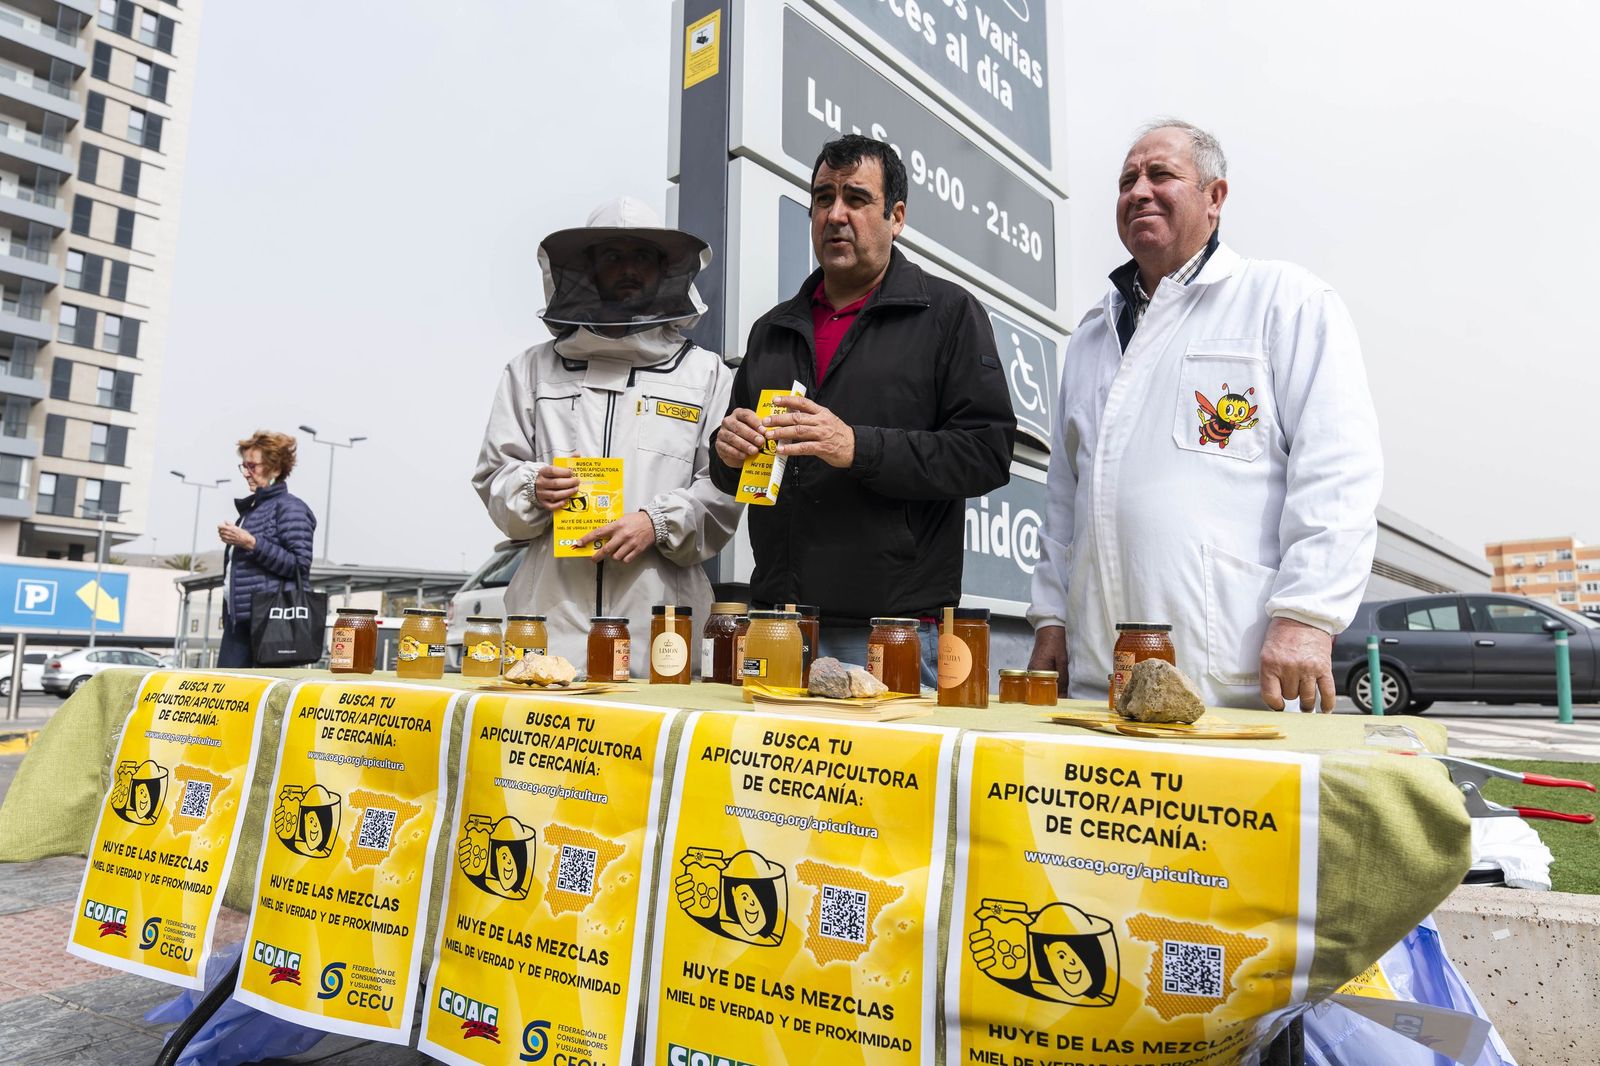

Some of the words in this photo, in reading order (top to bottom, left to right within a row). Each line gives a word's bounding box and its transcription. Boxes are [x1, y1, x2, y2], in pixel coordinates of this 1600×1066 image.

[975, 6, 1043, 88] varias
[946, 32, 968, 74] al
[977, 54, 1013, 112] día
[807, 76, 842, 133] Lu
[911, 150, 965, 211] 9:00
[986, 202, 1042, 262] 21:30
[178, 680, 209, 693] BUSCA
[211, 683, 226, 693] TU
[338, 693, 375, 707] BUSCA
[380, 696, 396, 709] TU
[143, 692, 249, 713] APICULTOR/APICULTORA
[158, 709, 172, 721] DE
[171, 710, 219, 727] CERCANÍA:
[298, 706, 432, 733] APICULTOR/APICULTORA
[525, 711, 571, 730] BUSCA
[577, 717, 595, 733] TU
[321, 726, 335, 740] DE
[336, 727, 397, 747] CERCANÍA:
[479, 726, 643, 761] APICULTOR/APICULTORA
[762, 731, 820, 753] BUSCA
[828, 738, 853, 756] TU
[307, 750, 406, 772] www.coag.org/apicultura
[508, 749, 526, 766] DE
[529, 752, 600, 776] CERCANÍA:
[701, 746, 919, 790] APICULTOR/APICULTORA
[494, 776, 608, 804] www.coag.org/apicultura
[742, 773, 764, 792] DE
[769, 777, 863, 807] CERCANÍA:
[1064, 763, 1141, 789] BUSCA
[1151, 772, 1183, 793] TU
[725, 804, 879, 839] www.coag.org/apicultura
[987, 782, 1278, 832] APICULTOR/APICULTORA
[1045, 814, 1073, 835] DE
[1080, 818, 1206, 851] CERCANÍA:
[102, 840, 123, 856] HUYE
[124, 844, 138, 859] DE
[138, 848, 157, 863] LAS
[158, 852, 209, 873] MEZCLAS
[1025, 850, 1229, 889] www.coag.org/apicultura
[93, 859, 105, 872] MIEL
[105, 863, 115, 874] DE
[115, 866, 142, 881] VERDAD
[144, 872, 150, 882] Y
[150, 873, 161, 885] DE
[161, 876, 213, 895] PROXIMIDAD
[269, 874, 295, 892] HUYE
[295, 880, 310, 896] DE
[311, 883, 334, 901] LAS
[336, 888, 400, 912] MEZCLAS
[85, 900, 127, 926] COAG
[261, 895, 274, 910] MIEL
[274, 900, 285, 913] DE
[285, 903, 317, 921] VERDAD
[320, 911, 327, 922] Y
[327, 913, 341, 926] DE
[342, 915, 409, 937] PROXIMIDAD
[160, 942, 193, 962] CECU
[456, 913, 487, 937] HUYE
[488, 923, 505, 942] DE
[507, 929, 533, 949] LAS
[536, 936, 609, 967] MEZCLAS
[255, 942, 300, 971] COAG
[352, 964, 386, 976] FEDERACIÓN
[445, 937, 463, 955] MIEL
[464, 944, 475, 959] DE
[477, 949, 515, 971] VERDAD
[518, 961, 526, 973] Y
[527, 963, 542, 978] DE
[543, 967, 621, 995] PROXIMIDAD
[350, 972, 396, 986] CONSUMIDORES
[354, 981, 382, 991] USUARIOS
[682, 960, 729, 987] HUYE
[734, 972, 756, 993] DE
[761, 979, 795, 1002] LAS
[801, 987, 894, 1021] MEZCLAS
[347, 989, 394, 1012] CECU
[440, 990, 497, 1026] COAG
[557, 1023, 598, 1039] FEDERACIÓN
[599, 1033, 607, 1041] DE
[666, 987, 696, 1007] MIEL
[699, 995, 716, 1011] DE
[719, 1000, 775, 1025] VERDAD
[779, 1014, 789, 1029] Y
[793, 1017, 811, 1034] DE
[815, 1022, 912, 1052] PROXIMIDAD
[556, 1033, 608, 1050] CONSUMIDORES
[560, 1044, 593, 1057] USUARIOS
[988, 1023, 1049, 1048] HUYE
[1056, 1034, 1084, 1051] DE
[1091, 1037, 1135, 1055] LAS
[969, 1047, 1008, 1066] MIEL
